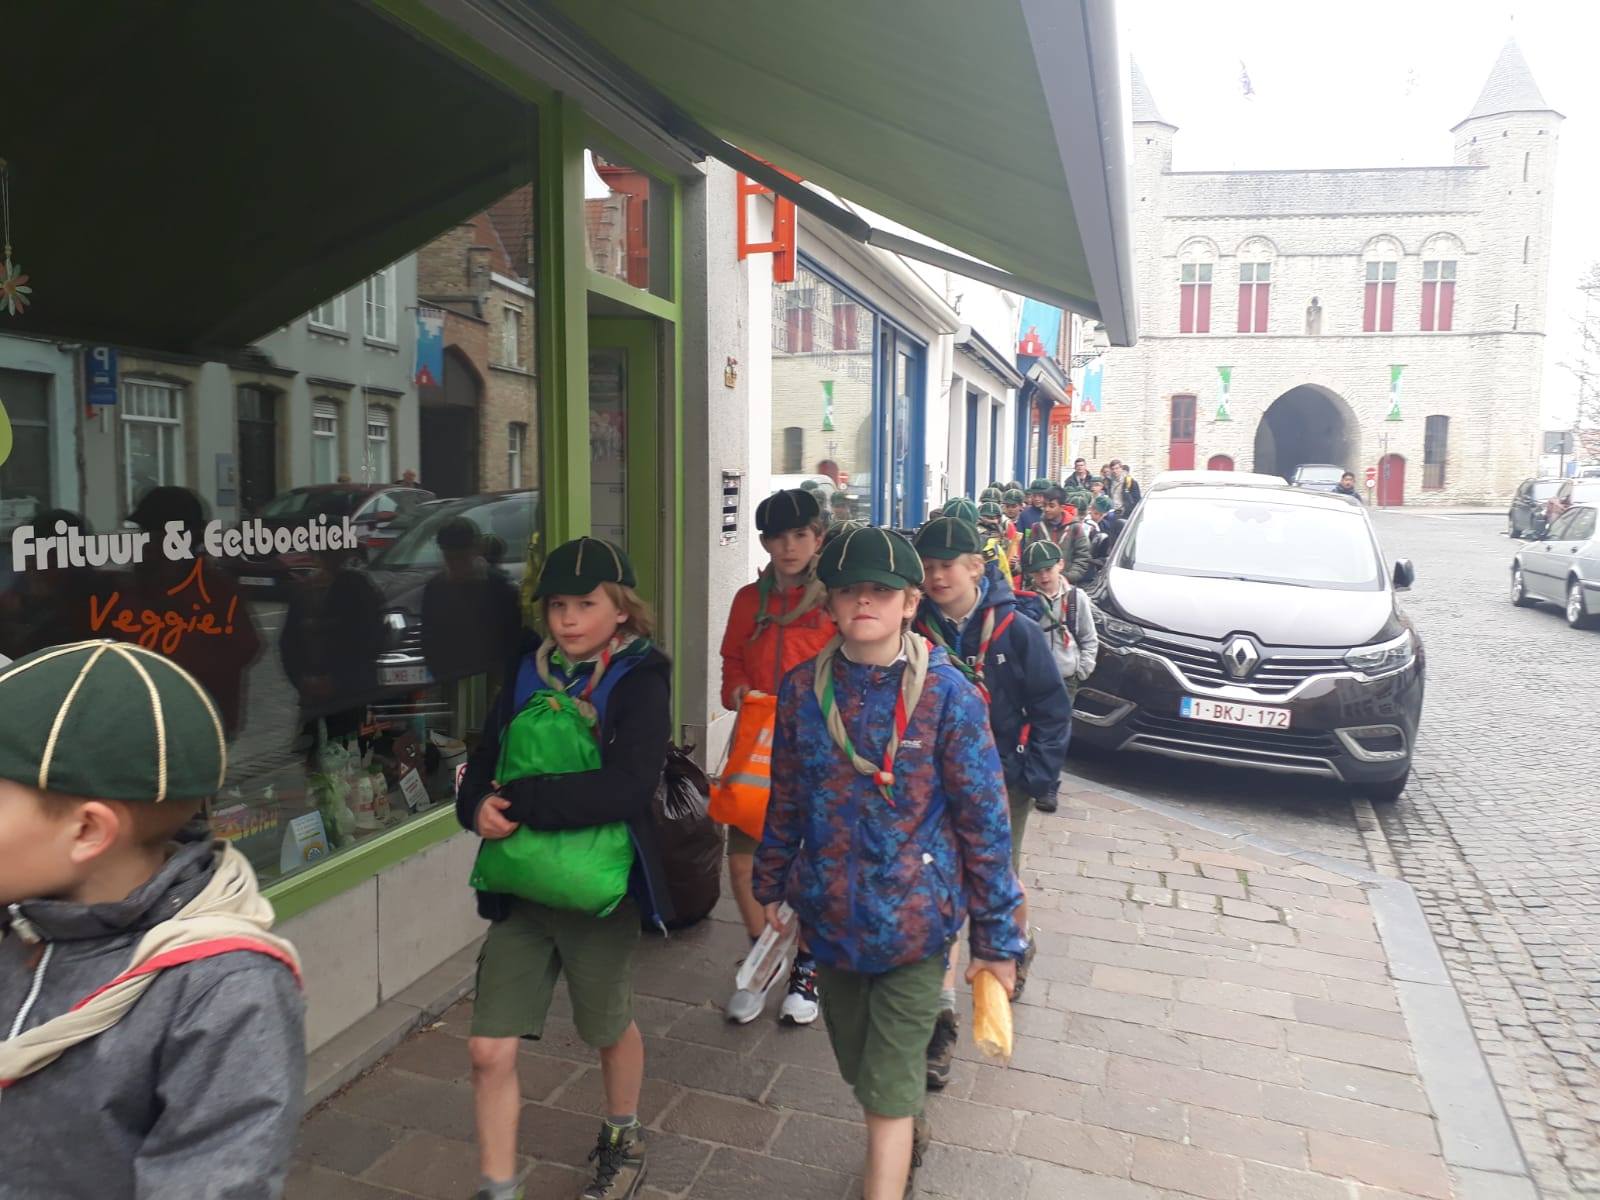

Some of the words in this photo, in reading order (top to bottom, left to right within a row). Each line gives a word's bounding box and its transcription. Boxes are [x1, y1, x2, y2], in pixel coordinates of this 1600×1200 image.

[12, 520, 150, 572] Frituur
[163, 520, 195, 561] &
[204, 513, 358, 557] Eetboetiek
[89, 591, 238, 655] Veggie!
[1194, 701, 1288, 727] 1-BKJ-172
